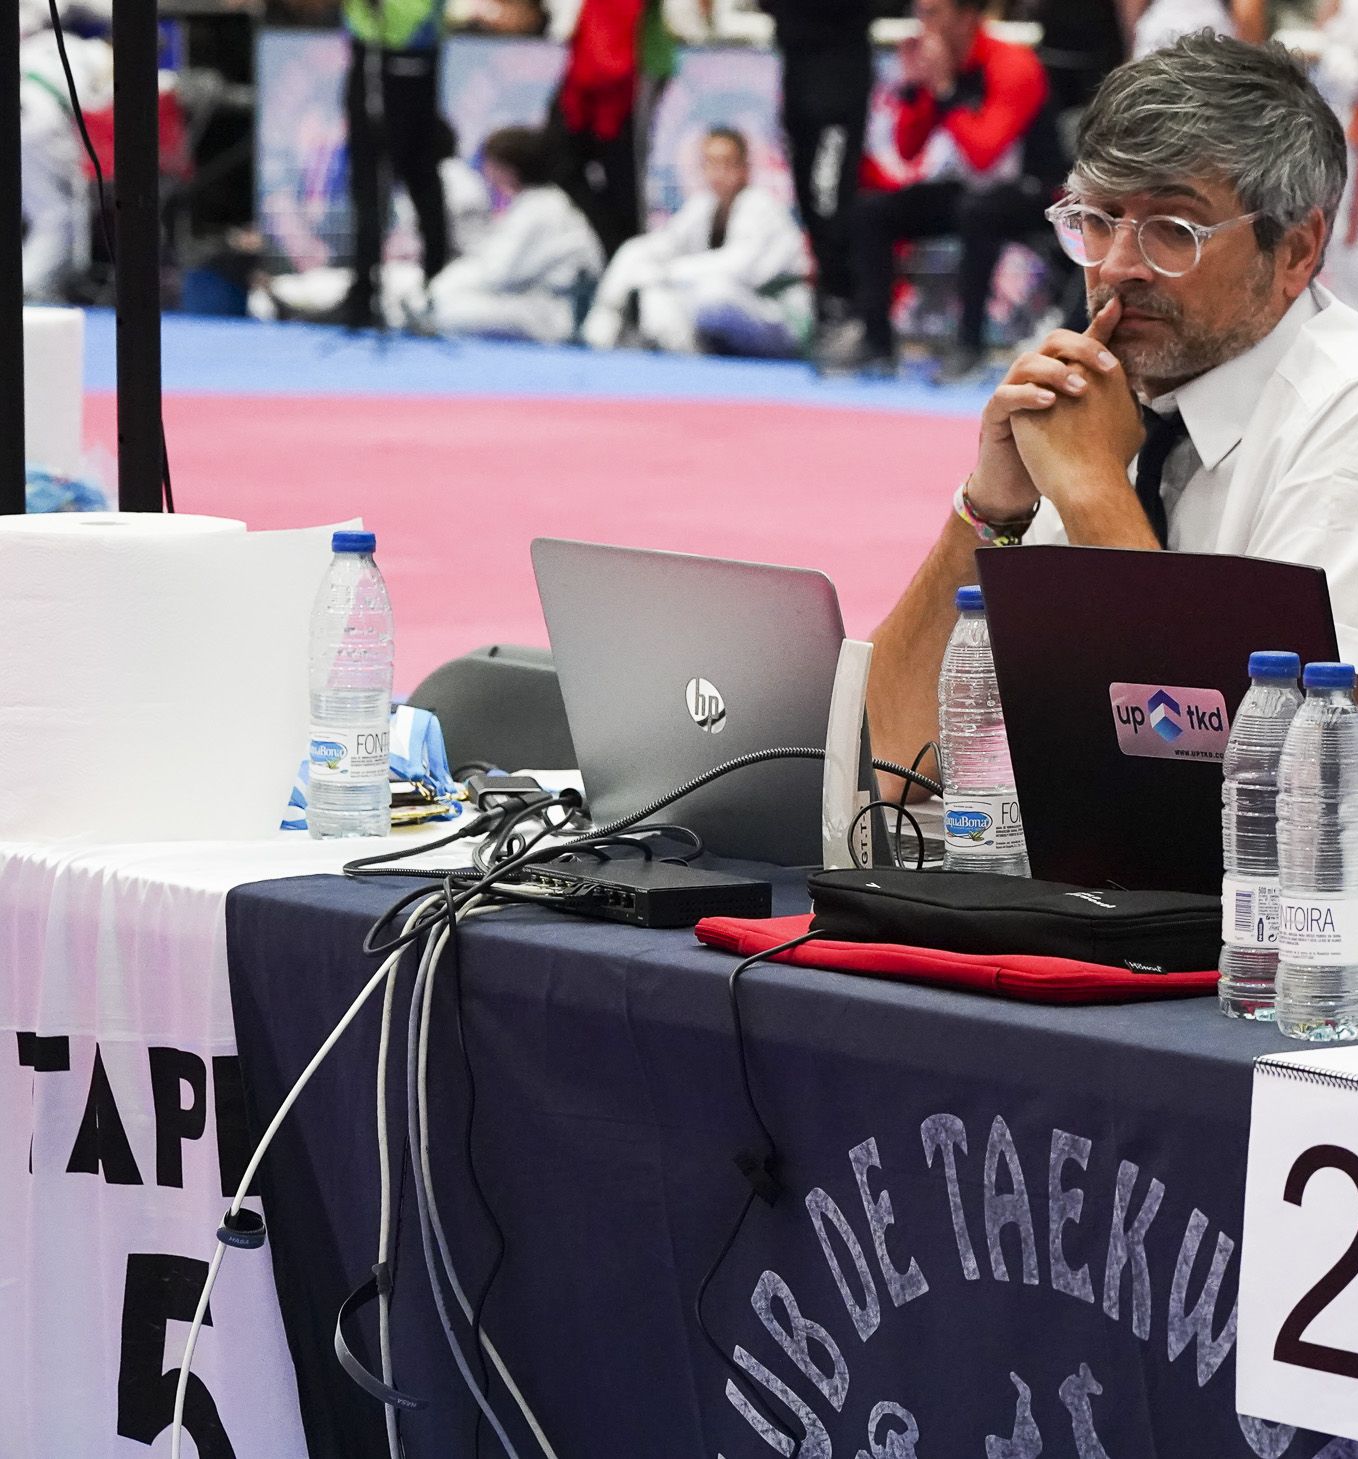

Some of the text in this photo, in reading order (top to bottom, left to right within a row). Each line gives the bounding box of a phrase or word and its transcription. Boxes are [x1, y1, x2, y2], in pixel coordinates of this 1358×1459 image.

[1116, 705, 1224, 734] up tkd
[1174, 749, 1224, 759] WWW.UPTKD.CO
[717, 1270, 850, 1459] UB
[805, 1137, 930, 1342] DE
